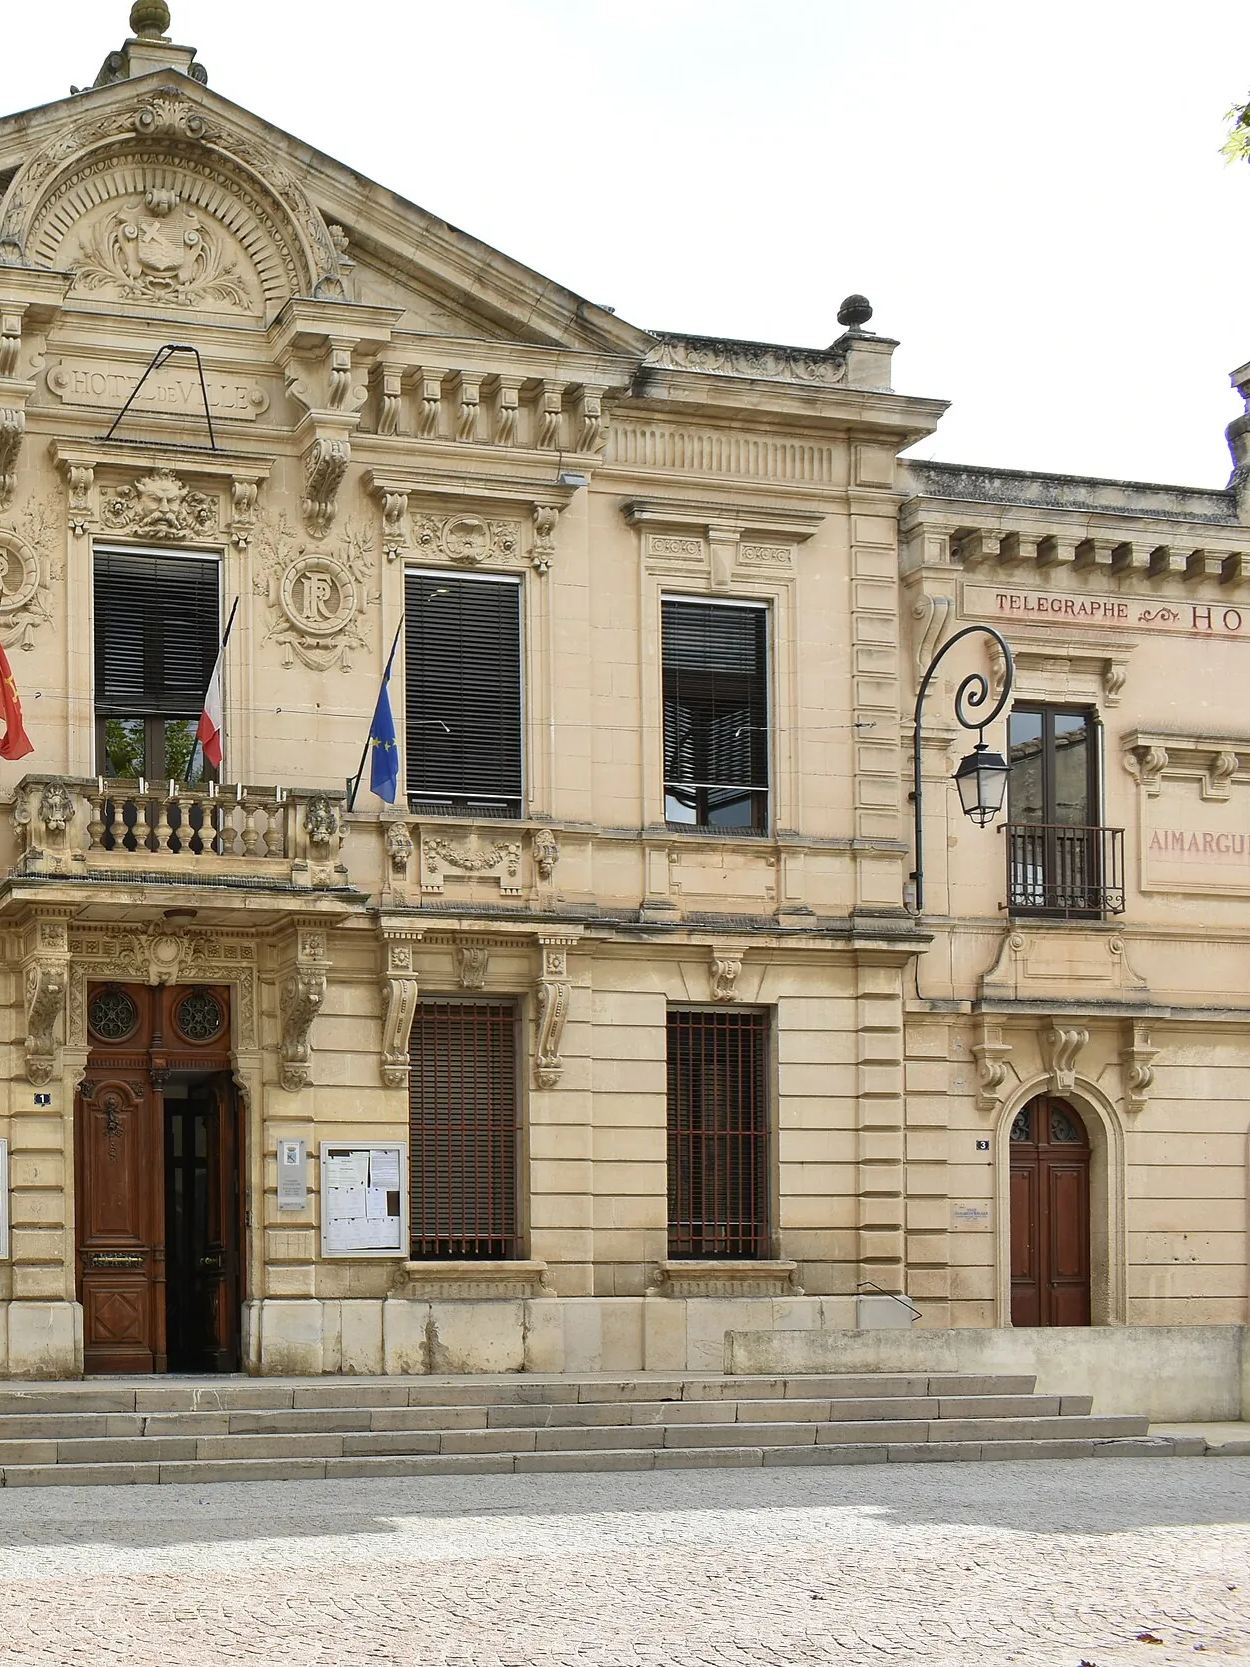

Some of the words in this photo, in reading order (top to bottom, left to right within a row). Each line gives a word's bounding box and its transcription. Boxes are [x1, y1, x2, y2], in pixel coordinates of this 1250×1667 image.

[71, 370, 156, 401] HOTEL
[158, 386, 177, 403] DE
[176, 380, 249, 410] VILLE
[995, 593, 1128, 618] TELEGRAPHE
[39, 1094, 45, 1103] 1
[980, 1141, 986, 1149] 3
